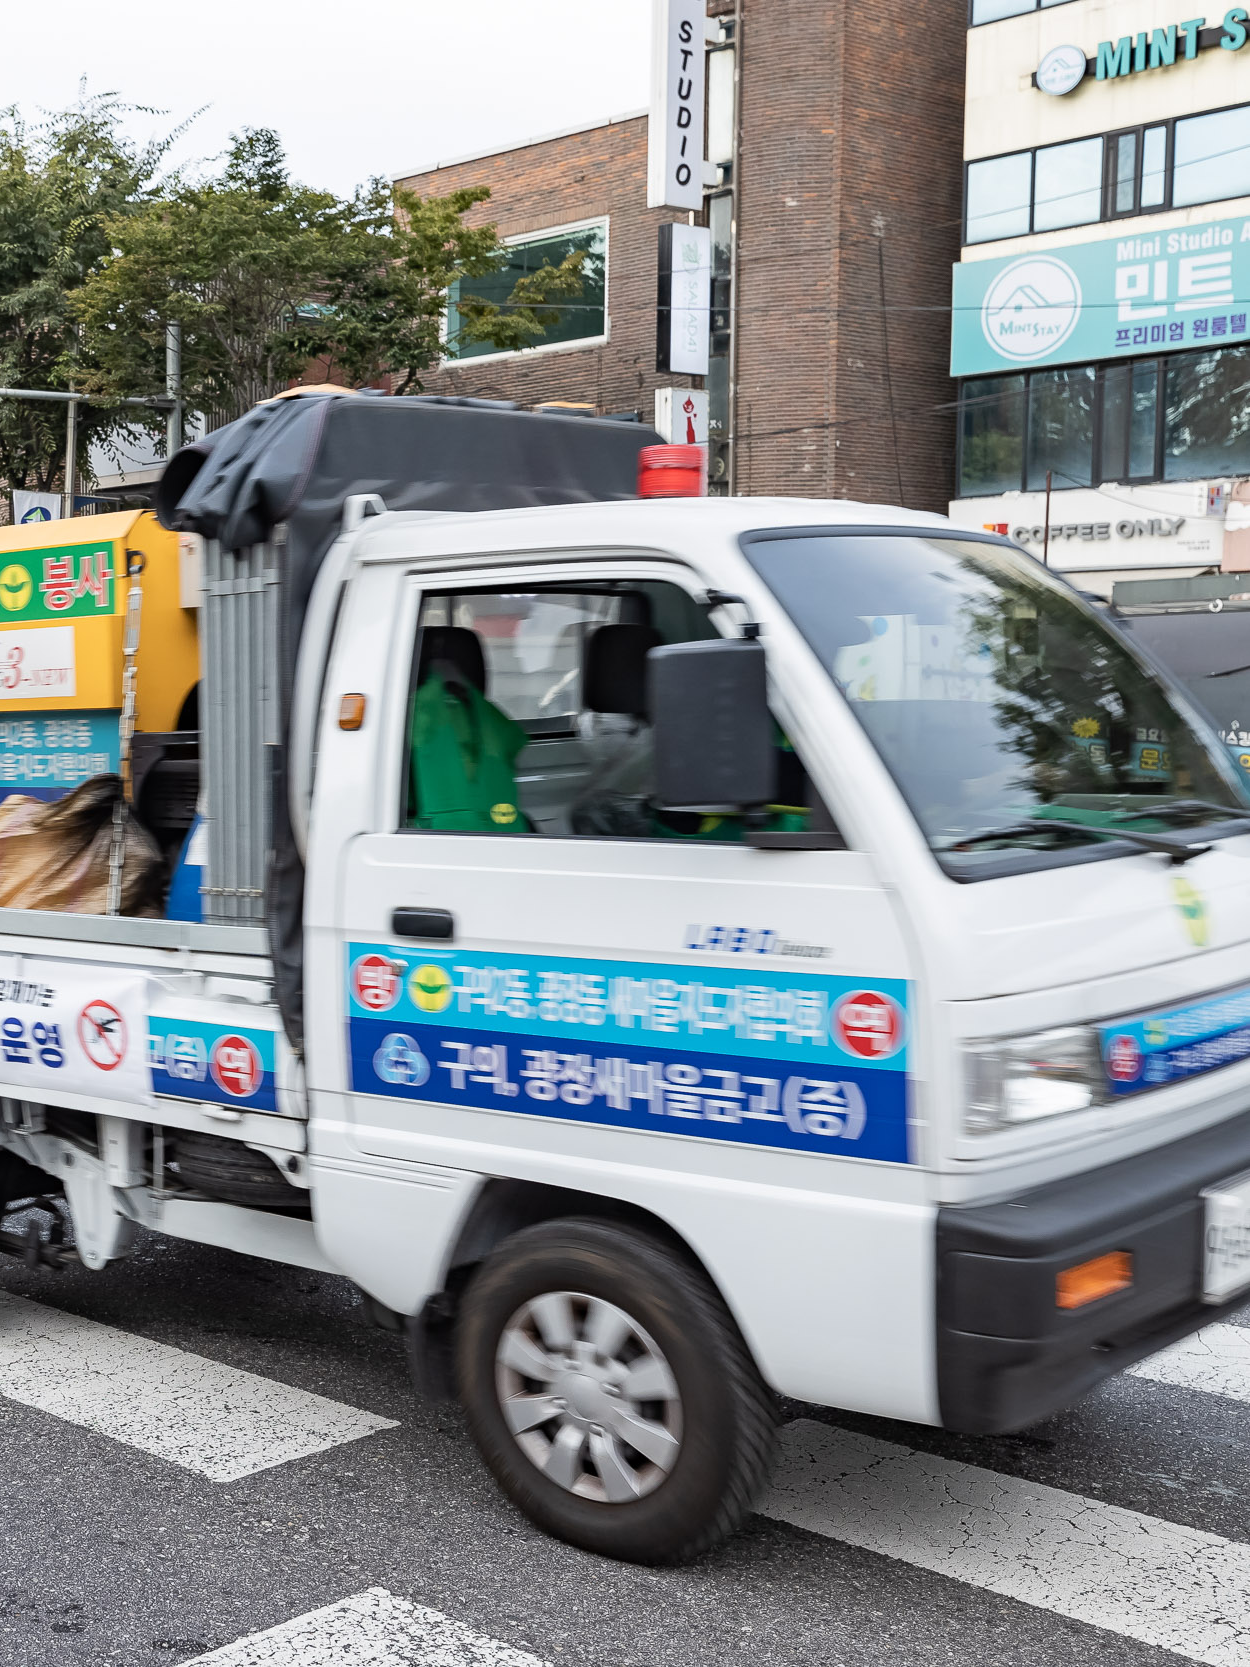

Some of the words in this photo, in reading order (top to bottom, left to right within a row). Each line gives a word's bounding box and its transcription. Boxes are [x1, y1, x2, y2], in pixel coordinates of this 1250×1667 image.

[1095, 17, 1206, 81] MINT
[1220, 7, 1248, 51] S
[675, 20, 693, 187] STUDIO
[1116, 237, 1161, 262] Mini
[1166, 228, 1234, 255] Studio
[1115, 250, 1235, 322] 민트
[1115, 322, 1185, 347] 프리미엄
[1193, 313, 1247, 339] 원룸텔
[1012, 521, 1111, 544] COFFEE
[1116, 517, 1186, 539] ONLY
[39, 551, 114, 612] 봉사
[0, 1016, 65, 1069] 운영
